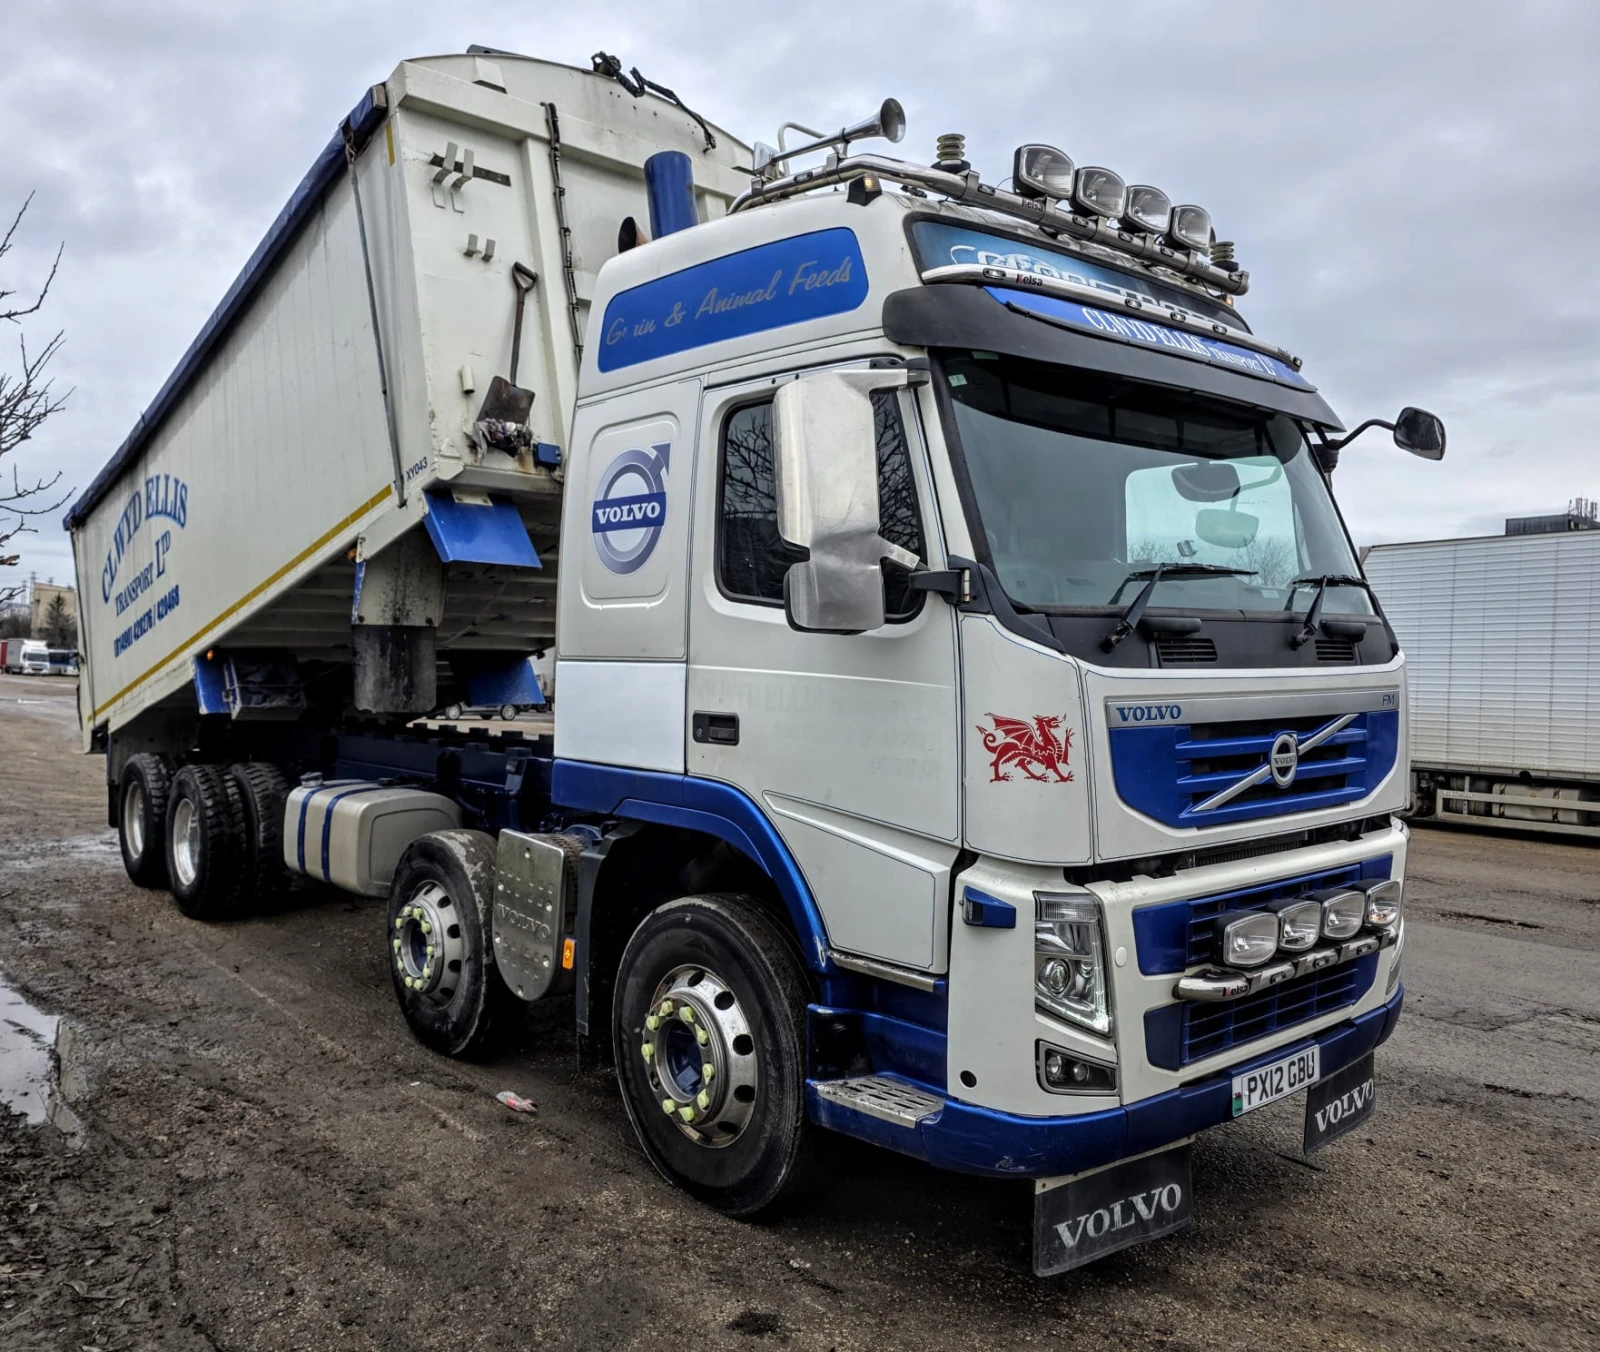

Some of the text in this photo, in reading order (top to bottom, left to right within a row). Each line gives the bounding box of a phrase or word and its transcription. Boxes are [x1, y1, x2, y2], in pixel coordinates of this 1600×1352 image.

[605, 255, 853, 345] Grin & Animal Feeds
[1015, 273, 1043, 287] Kelsa
[1081, 307, 1158, 342] CLWYD
[1156, 325, 1211, 357] ELLIS
[405, 456, 428, 482] XY043
[596, 501, 661, 525] VOLVO
[101, 473, 188, 605] CLWYD ELLIS
[114, 529, 172, 617] TRANSPORT LTD
[1116, 704, 1182, 722] VOLVO
[1382, 693, 1396, 707] FM
[1273, 755, 1298, 766] VOLVO
[497, 902, 551, 940] VOLVO
[1247, 1051, 1315, 1106] PX12 GBU
[1314, 1078, 1374, 1133] VOLVO
[1053, 1182, 1182, 1249] VOLVO
